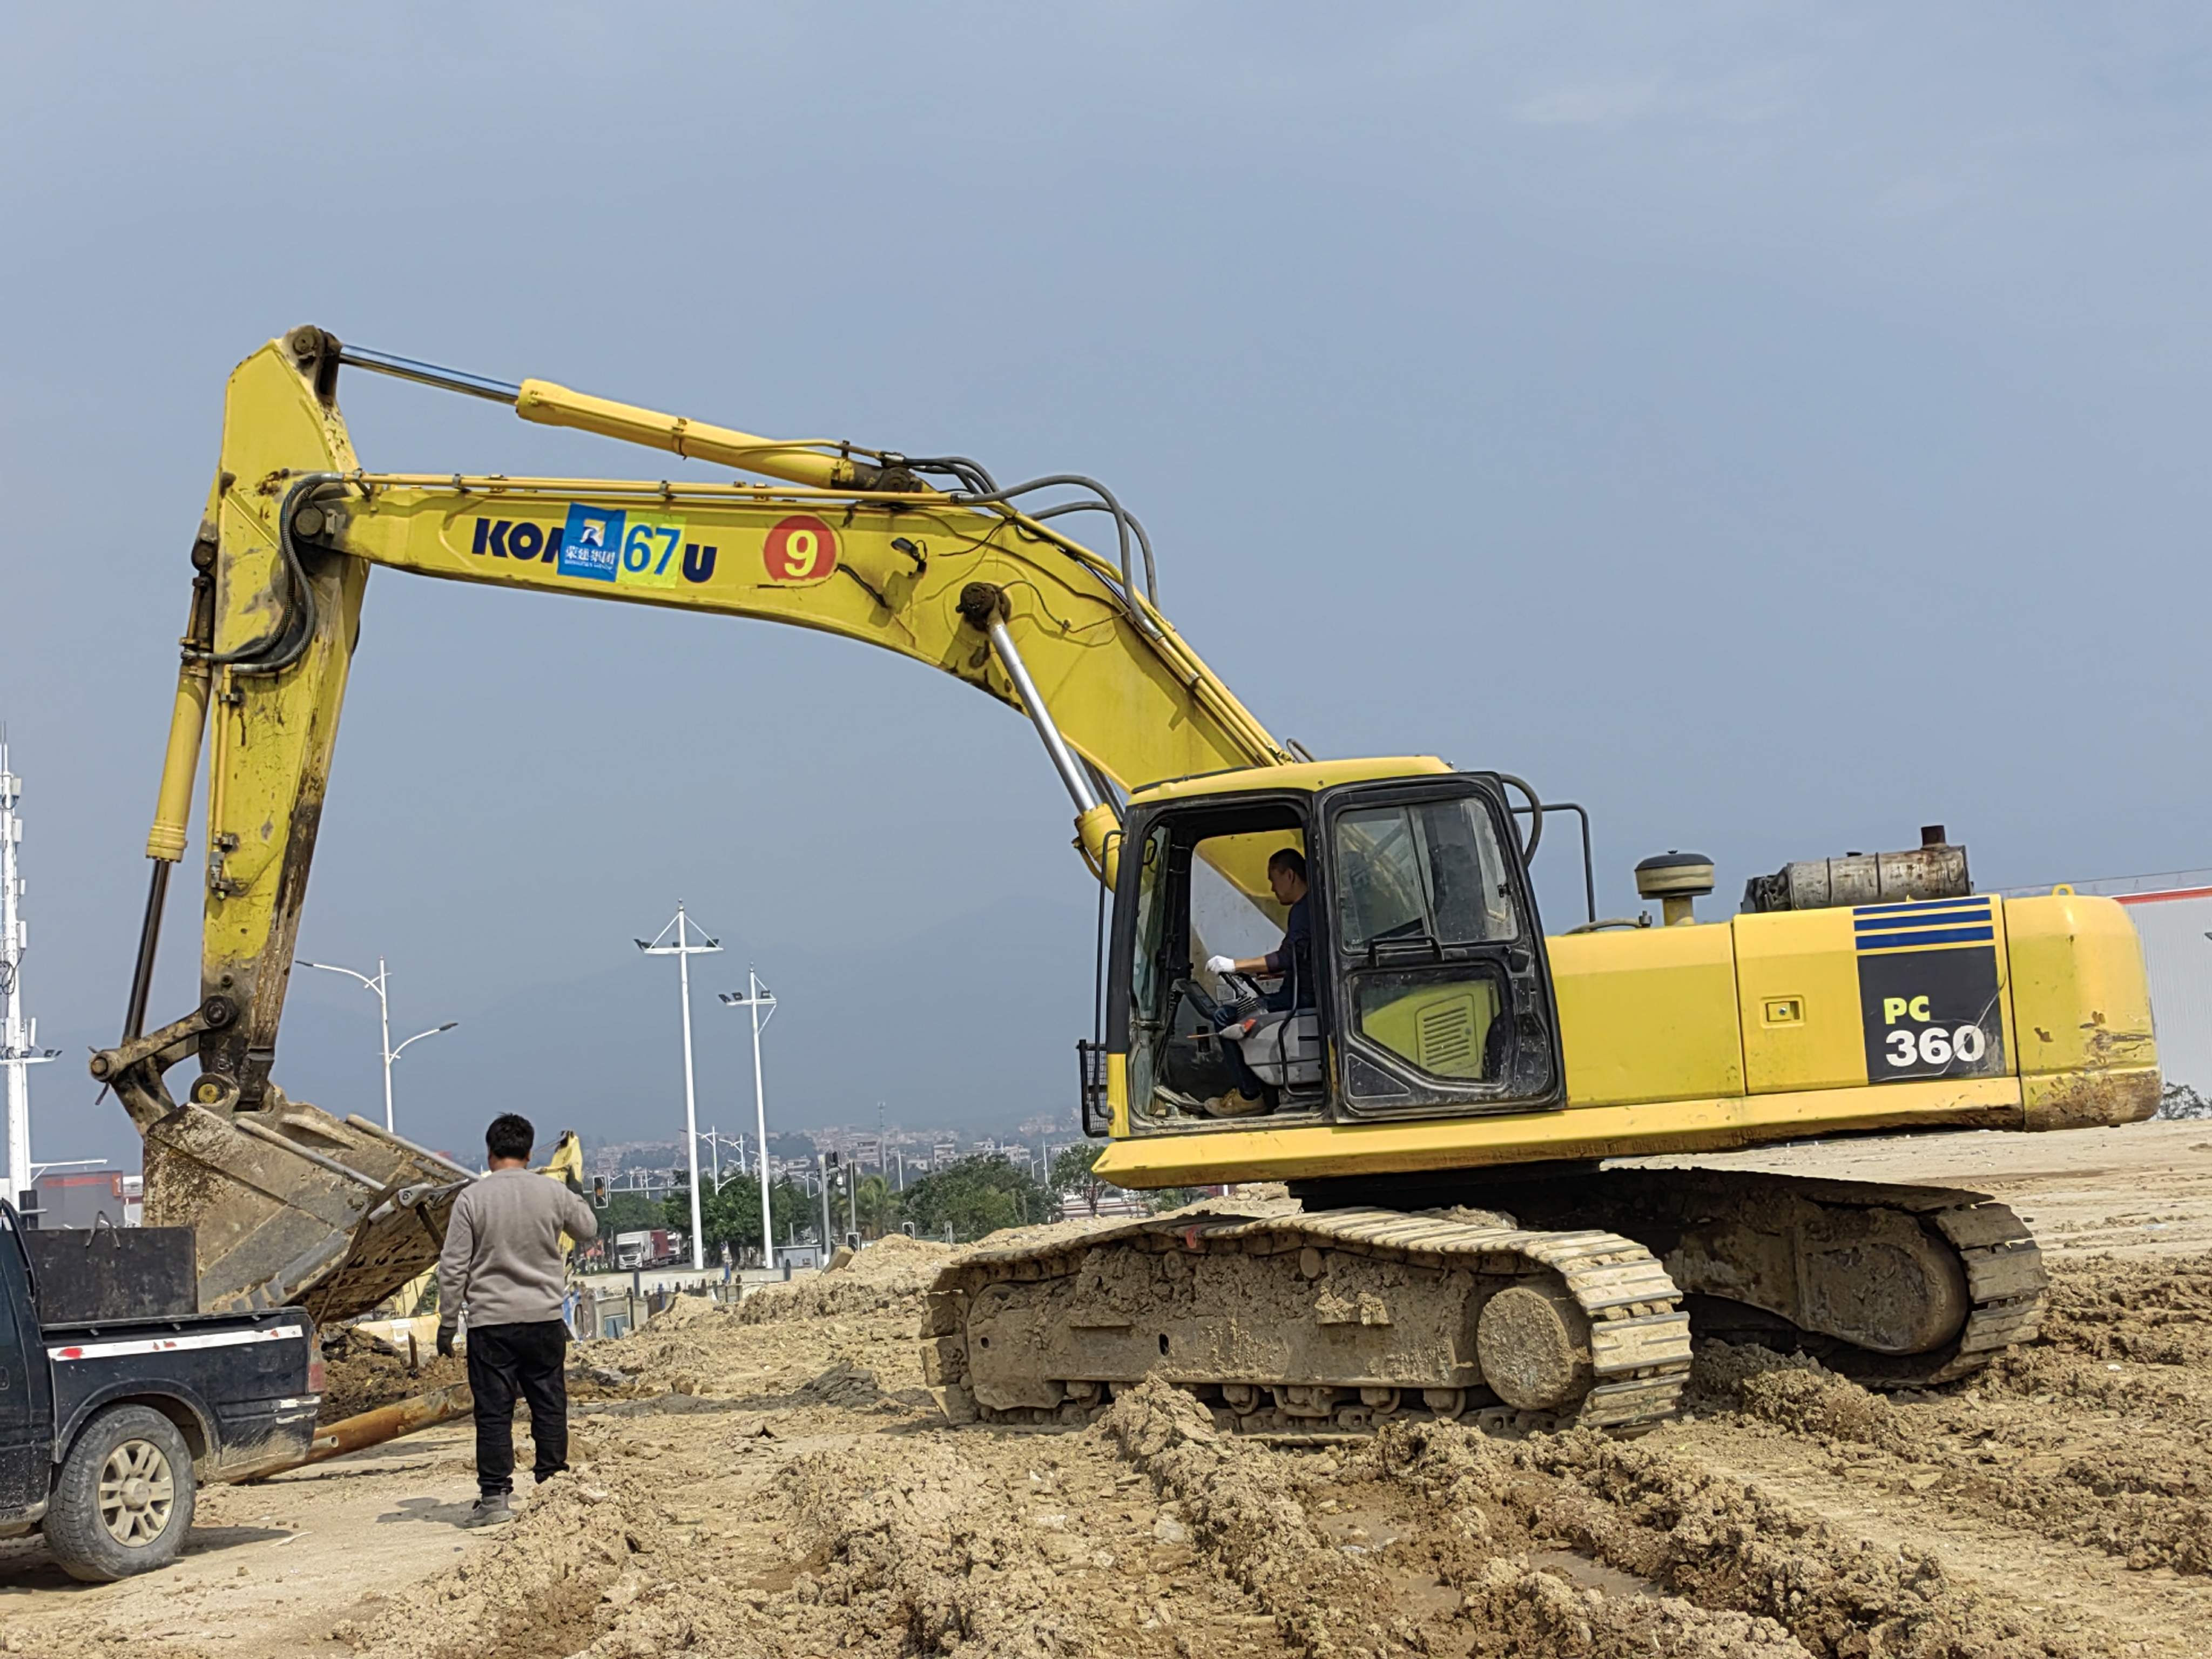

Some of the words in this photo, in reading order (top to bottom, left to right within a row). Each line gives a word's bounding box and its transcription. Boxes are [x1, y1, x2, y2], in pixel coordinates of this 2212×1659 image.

[623, 524, 681, 575] 67
[785, 530, 818, 577] 9
[1884, 995, 1931, 1024] PC
[1886, 1025, 1985, 1067] 360
